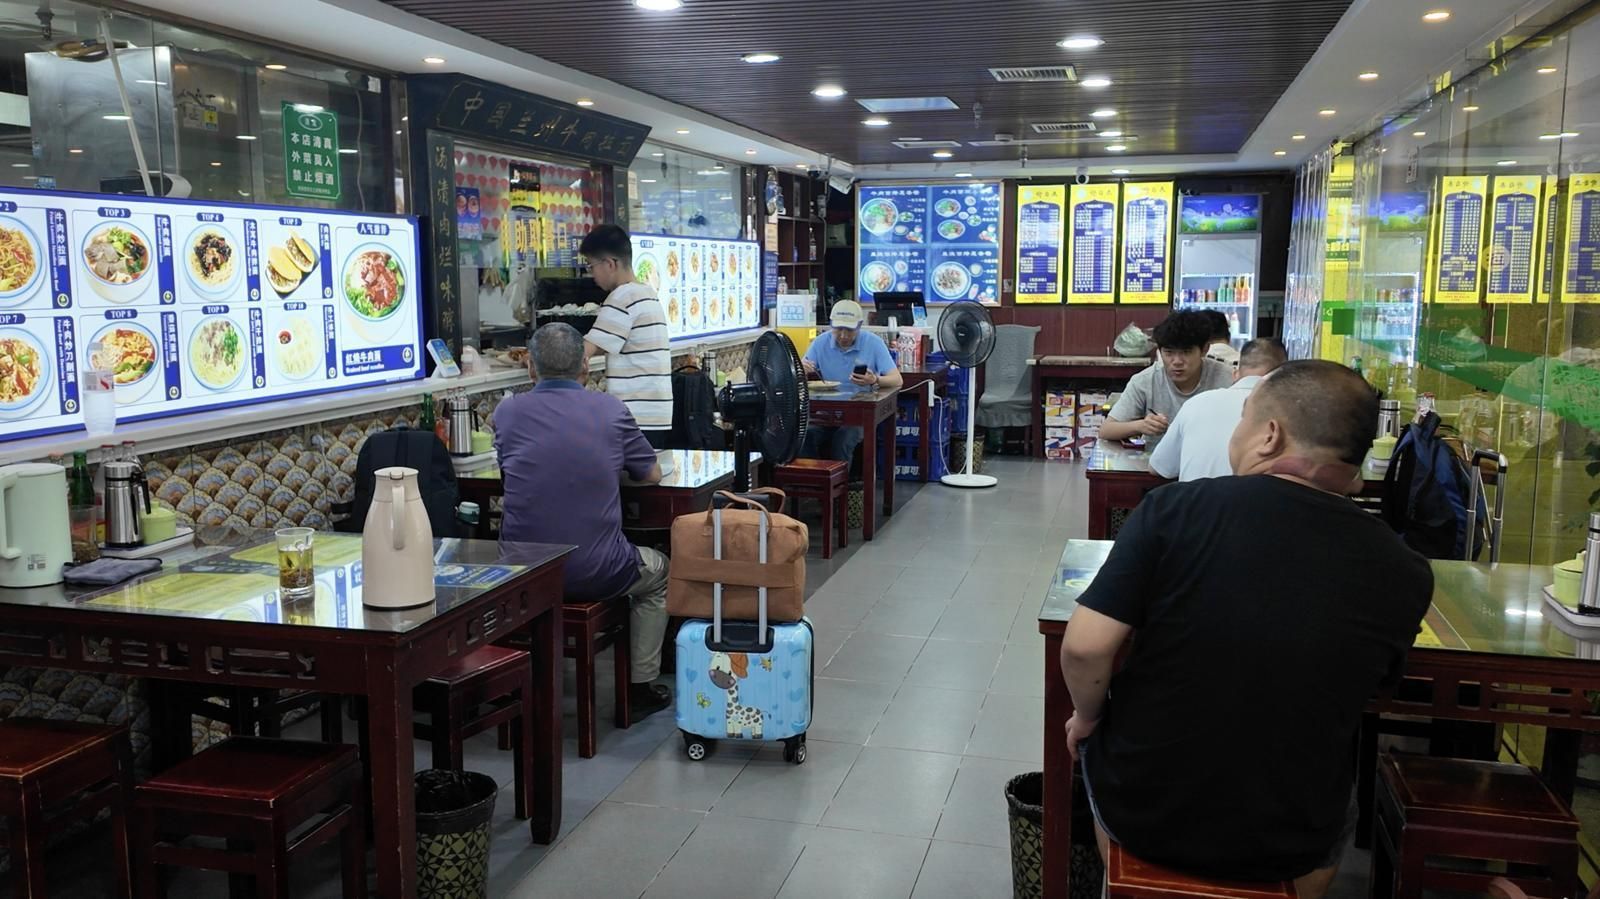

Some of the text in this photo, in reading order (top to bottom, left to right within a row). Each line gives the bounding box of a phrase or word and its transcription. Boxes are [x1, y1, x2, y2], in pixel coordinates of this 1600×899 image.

[290, 132, 333, 150] 本店清真
[291, 150, 334, 168] 外菜莫入
[292, 168, 335, 186] 禁止烟酒
[104, 208, 126, 218] TOP 3
[201, 213, 214, 221] TOP
[110, 310, 126, 319] TOP
[207, 305, 220, 314] TOP
[62, 318, 76, 383] 牛肉炒刀削面
